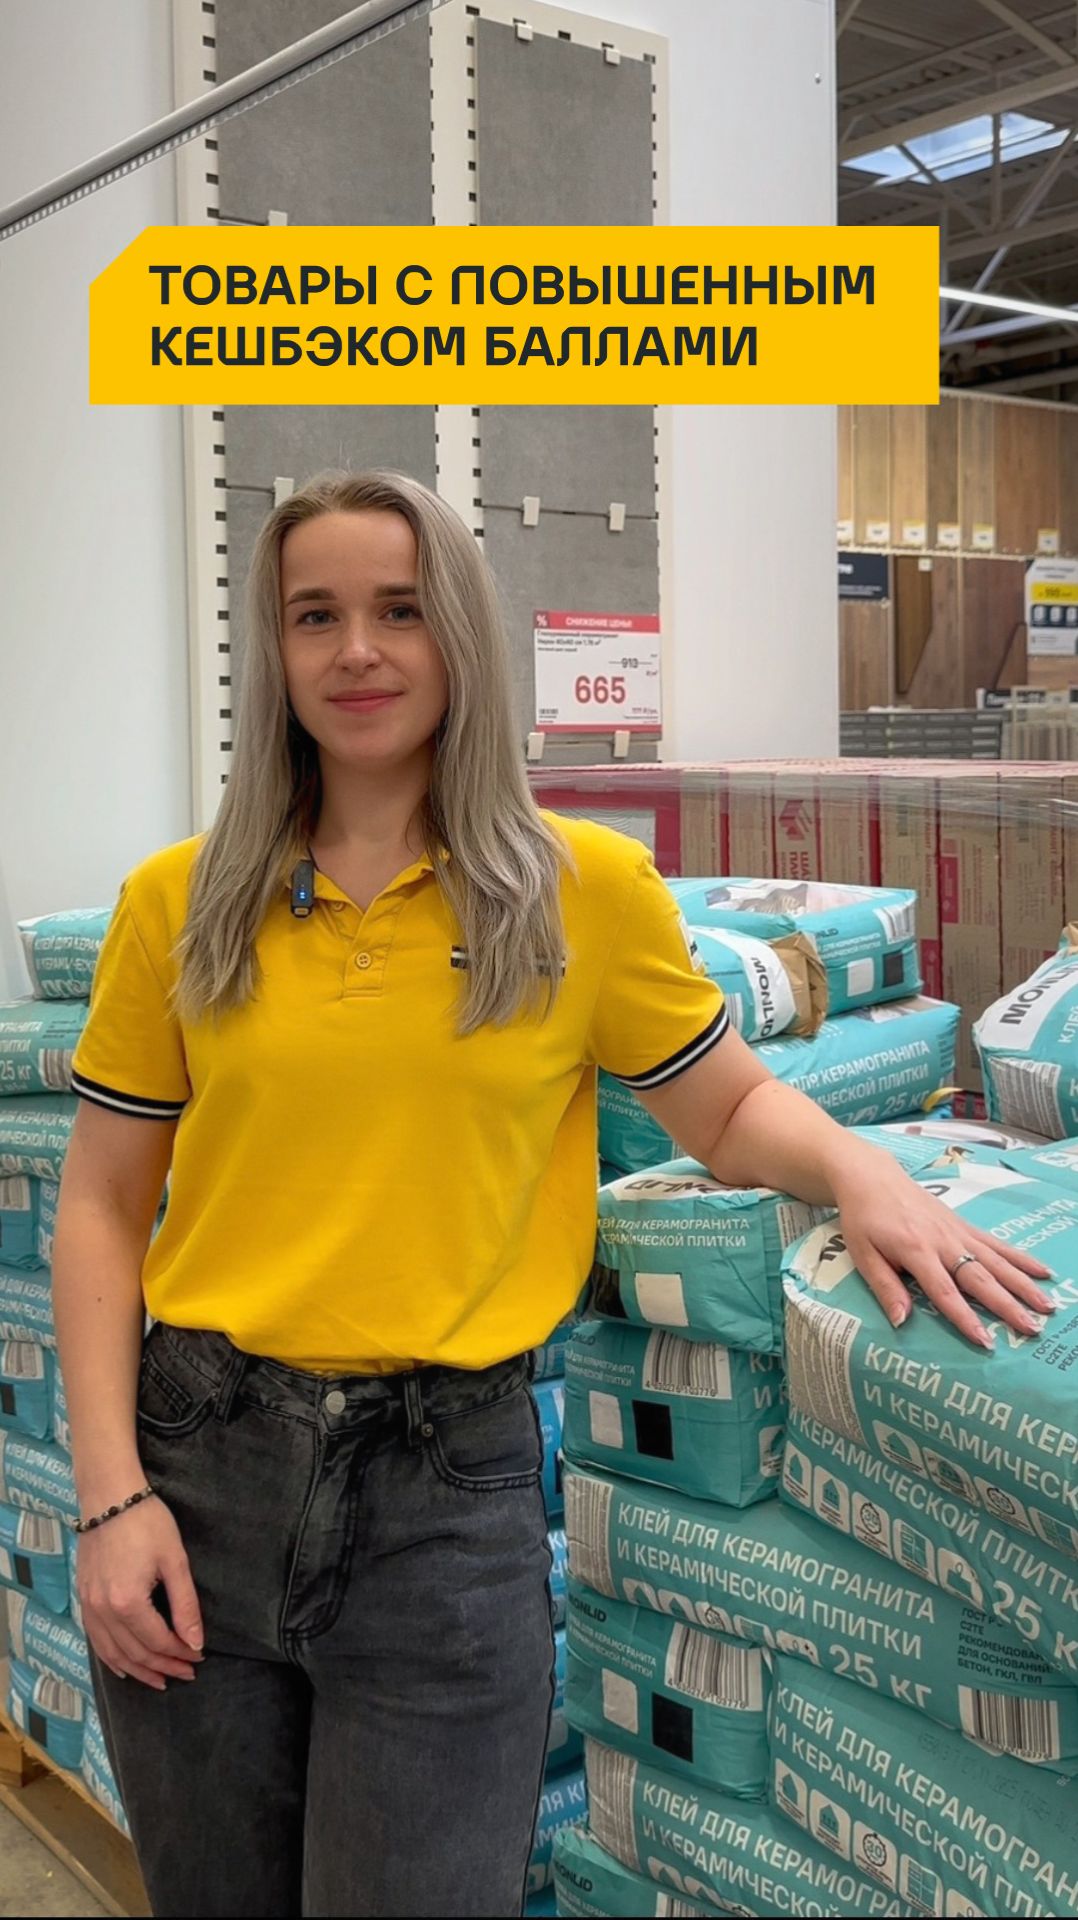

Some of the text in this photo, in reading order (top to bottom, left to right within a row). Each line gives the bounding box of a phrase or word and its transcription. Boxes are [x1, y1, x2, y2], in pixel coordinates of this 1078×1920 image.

[575, 675, 626, 704] 665
[750, 956, 776, 1037] MONLID
[811, 1063, 930, 1109] ИЧЕСКОЙ ПЛИТКИ
[821, 1039, 931, 1087] КЕРАМОГРАНИТА
[880, 1091, 909, 1117] 25
[641, 1218, 750, 1230] КЕРАМОГРАНИТА
[687, 1235, 747, 1248] ПЛИТКИ
[863, 1380, 883, 1408] И
[864, 1341, 944, 1398] КЛЕЙ
[943, 1380, 1013, 1432] ДЛЯ
[800, 1412, 981, 1545] КЕРАМИЧЕСКОЙ
[617, 1502, 670, 1538] КЛЕЙ
[672, 1519, 720, 1549] ДЛЯ
[722, 1532, 936, 1624] КЕРАМОГРАНИТА
[616, 1537, 630, 1561] И
[634, 1540, 805, 1619] КЕРАМИЧЕСКОЙ
[812, 1600, 922, 1660] ПЛИТКИ
[961, 1607, 987, 1623] ГОСТ
[992, 1580, 1042, 1641] 25
[960, 1620, 985, 1636] С2ТЕ
[957, 1645, 979, 1659] ДЛЯ
[994, 1668, 1019, 1682] ГКЛ,
[828, 1643, 932, 1709] 25 кг
[642, 1780, 699, 1826] КЛЕЙ
[699, 1808, 752, 1851] ДЛЯ
[775, 1716, 787, 1745] И
[791, 1732, 988, 1889] КЕРАМИЧЕСКОЙ
[776, 1681, 835, 1740] КЛЕЙ
[834, 1726, 892, 1779] ДЛЯ
[894, 1762, 1078, 1912] КЕРАМОГРАН
[642, 1815, 656, 1842] И
